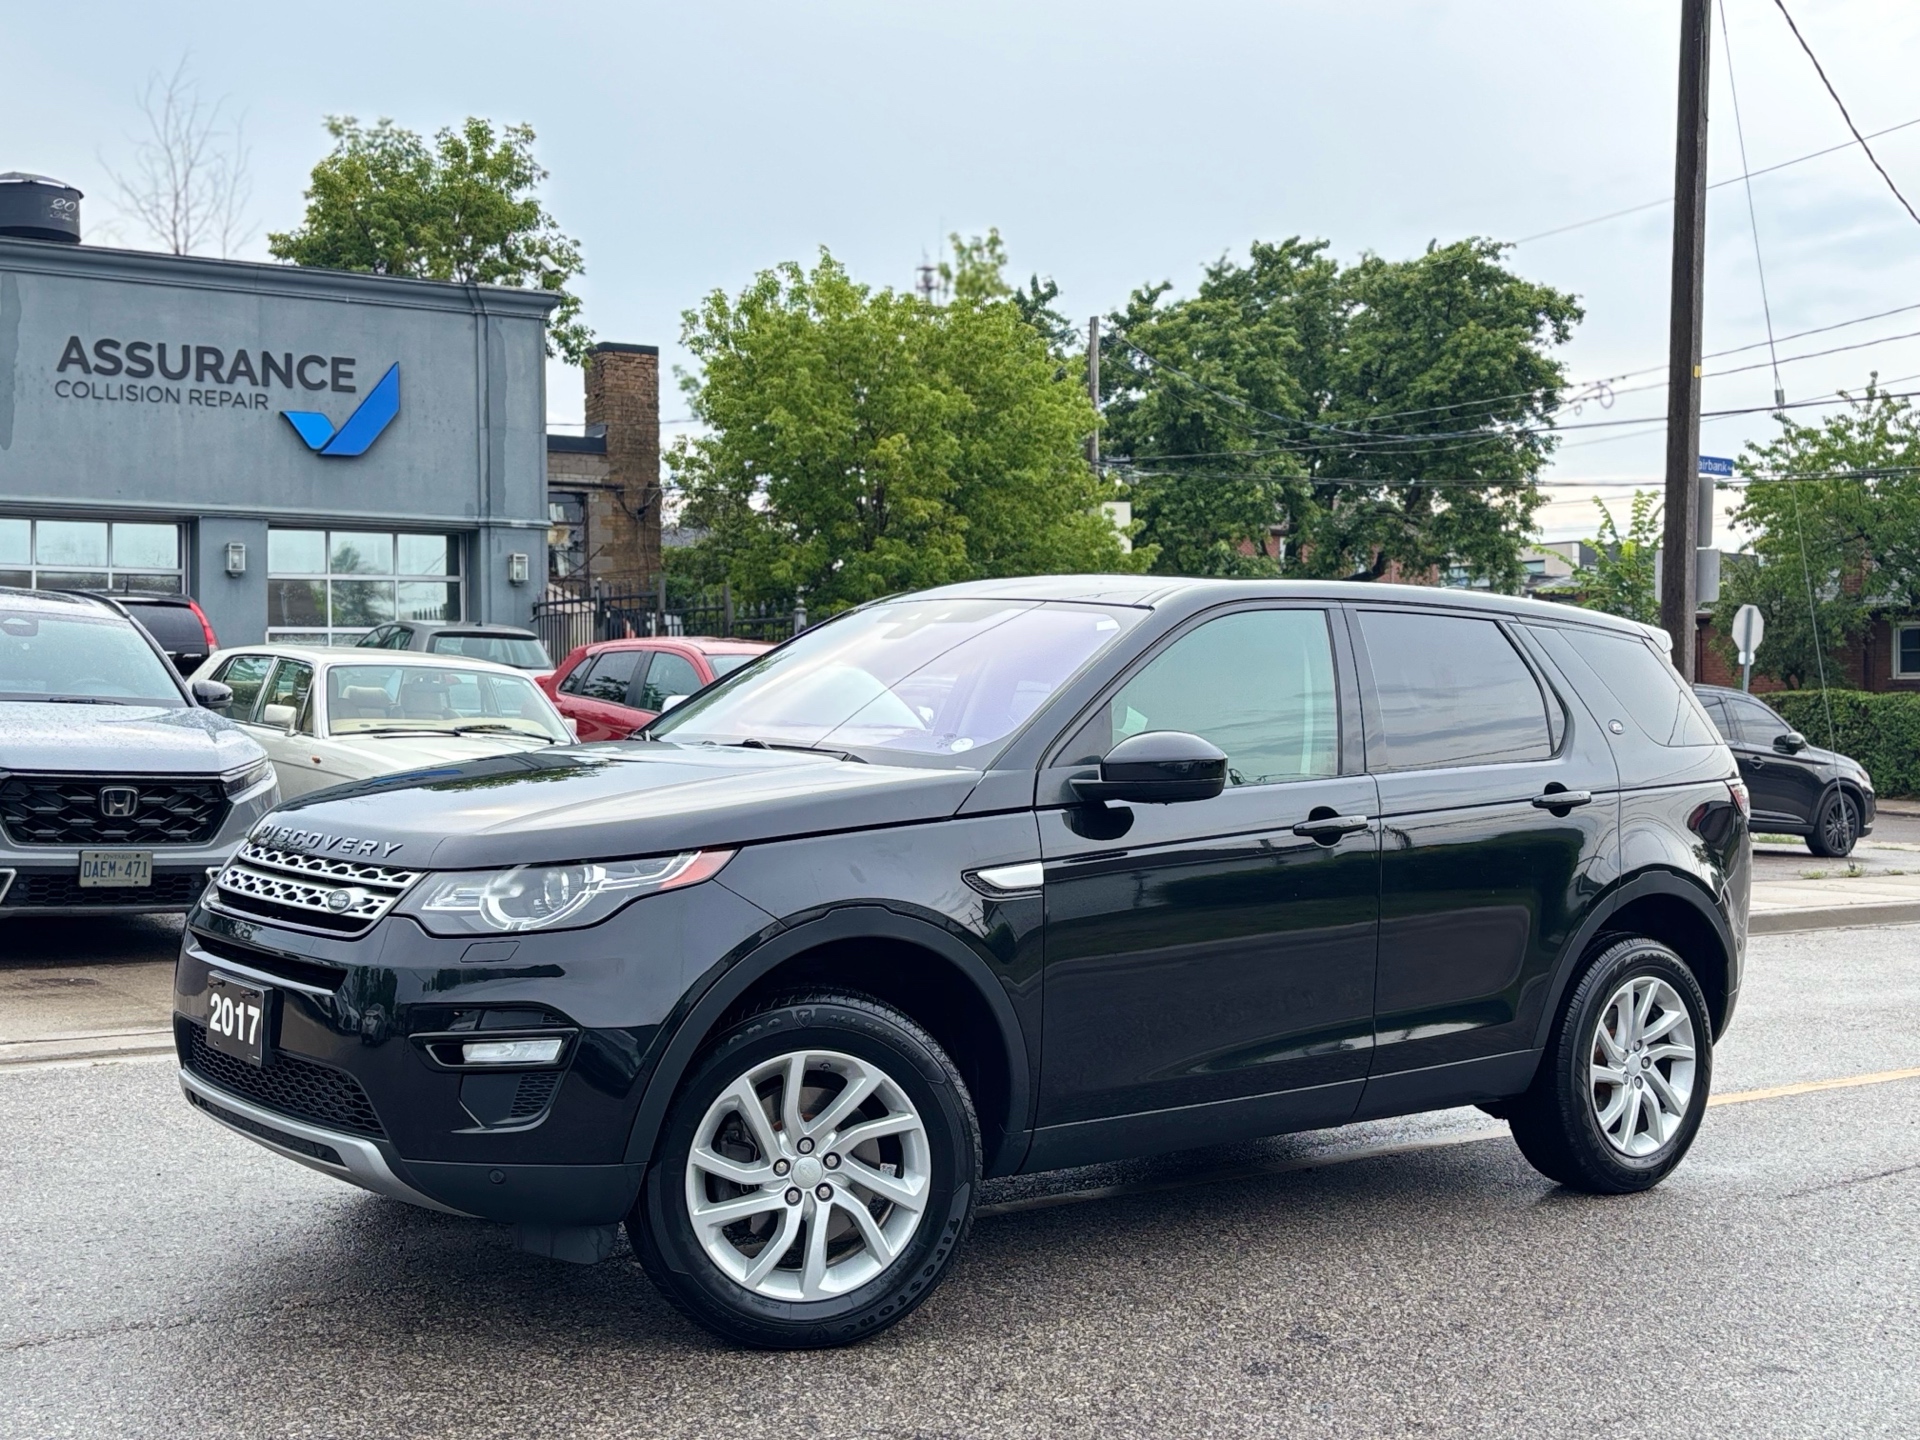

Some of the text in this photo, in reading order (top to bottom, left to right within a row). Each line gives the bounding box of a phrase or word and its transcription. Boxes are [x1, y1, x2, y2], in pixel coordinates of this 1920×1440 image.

[57, 336, 356, 393] ASSURANCE
[54, 380, 269, 411] COLLISION REPAIR
[261, 823, 403, 858] DISCOVERY
[83, 861, 148, 878] DAEM 471
[210, 992, 260, 1045] 2017
[839, 1217, 961, 1334] Firestone
